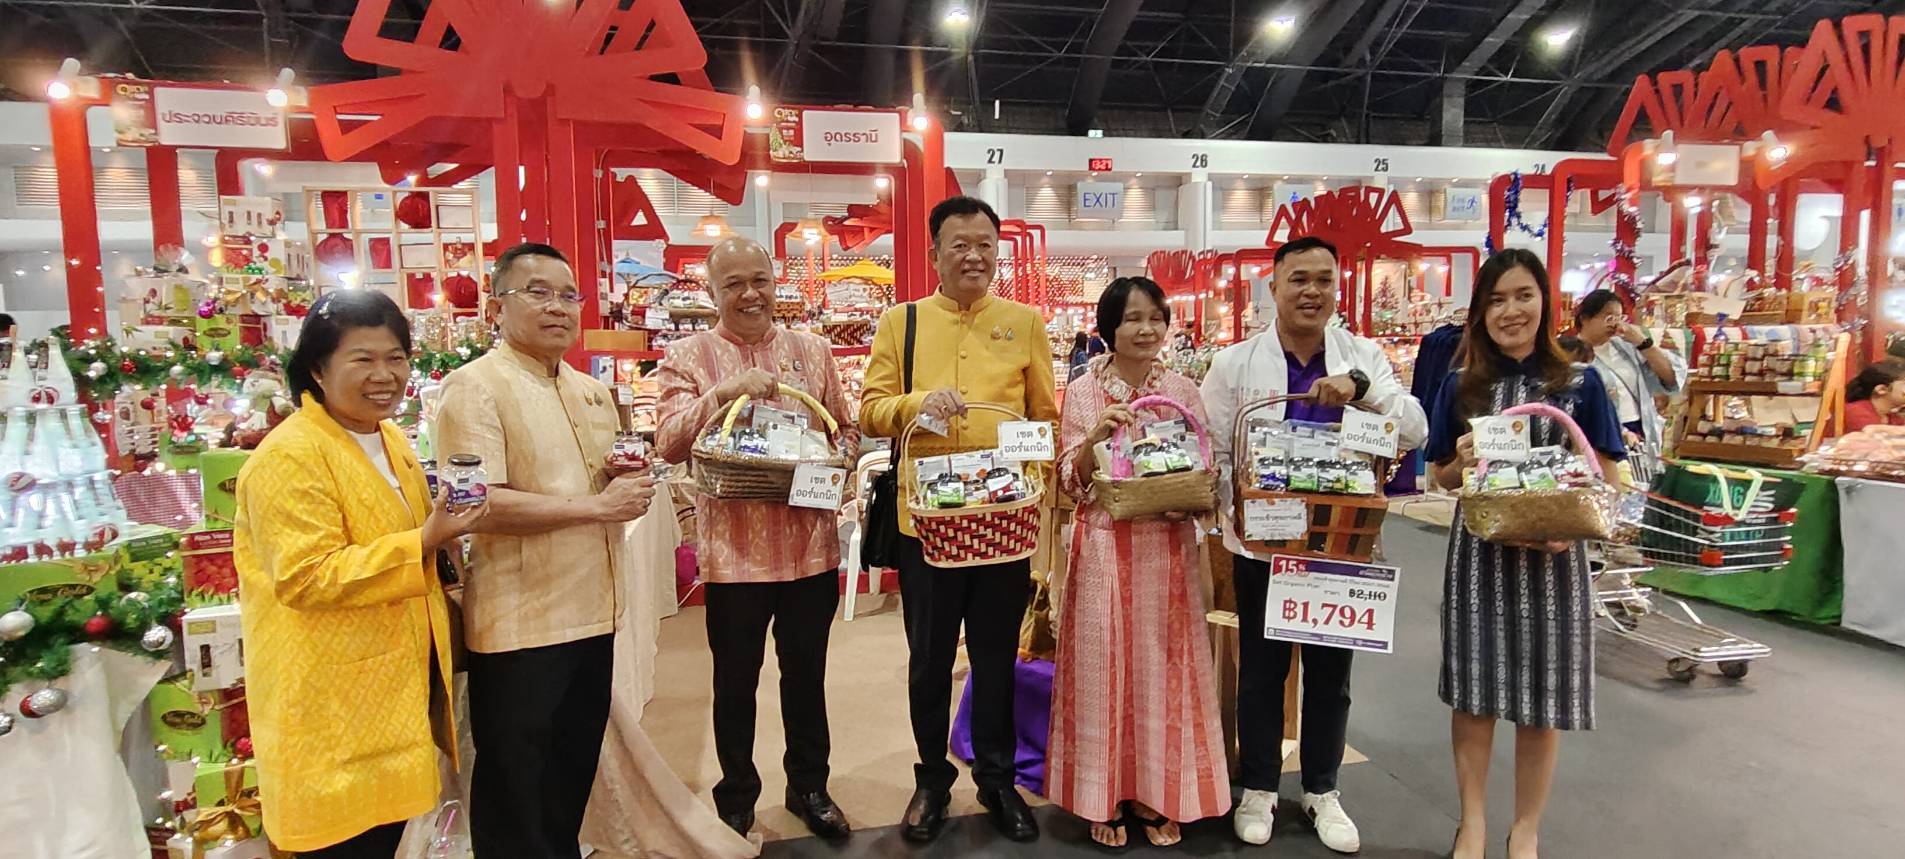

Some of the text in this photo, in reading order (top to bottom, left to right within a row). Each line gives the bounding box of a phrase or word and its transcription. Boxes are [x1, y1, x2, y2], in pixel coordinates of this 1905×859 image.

[823, 129, 879, 147] อุดรธานี
[987, 148, 1005, 164] 27
[1191, 153, 1208, 169] 26
[1373, 158, 1389, 172] 25
[1082, 192, 1119, 208] EXIT
[1004, 441, 1049, 453] ออร์แกนิก
[796, 487, 837, 501] ออร์แกนิก
[1282, 598, 1376, 631] ฿1,794
